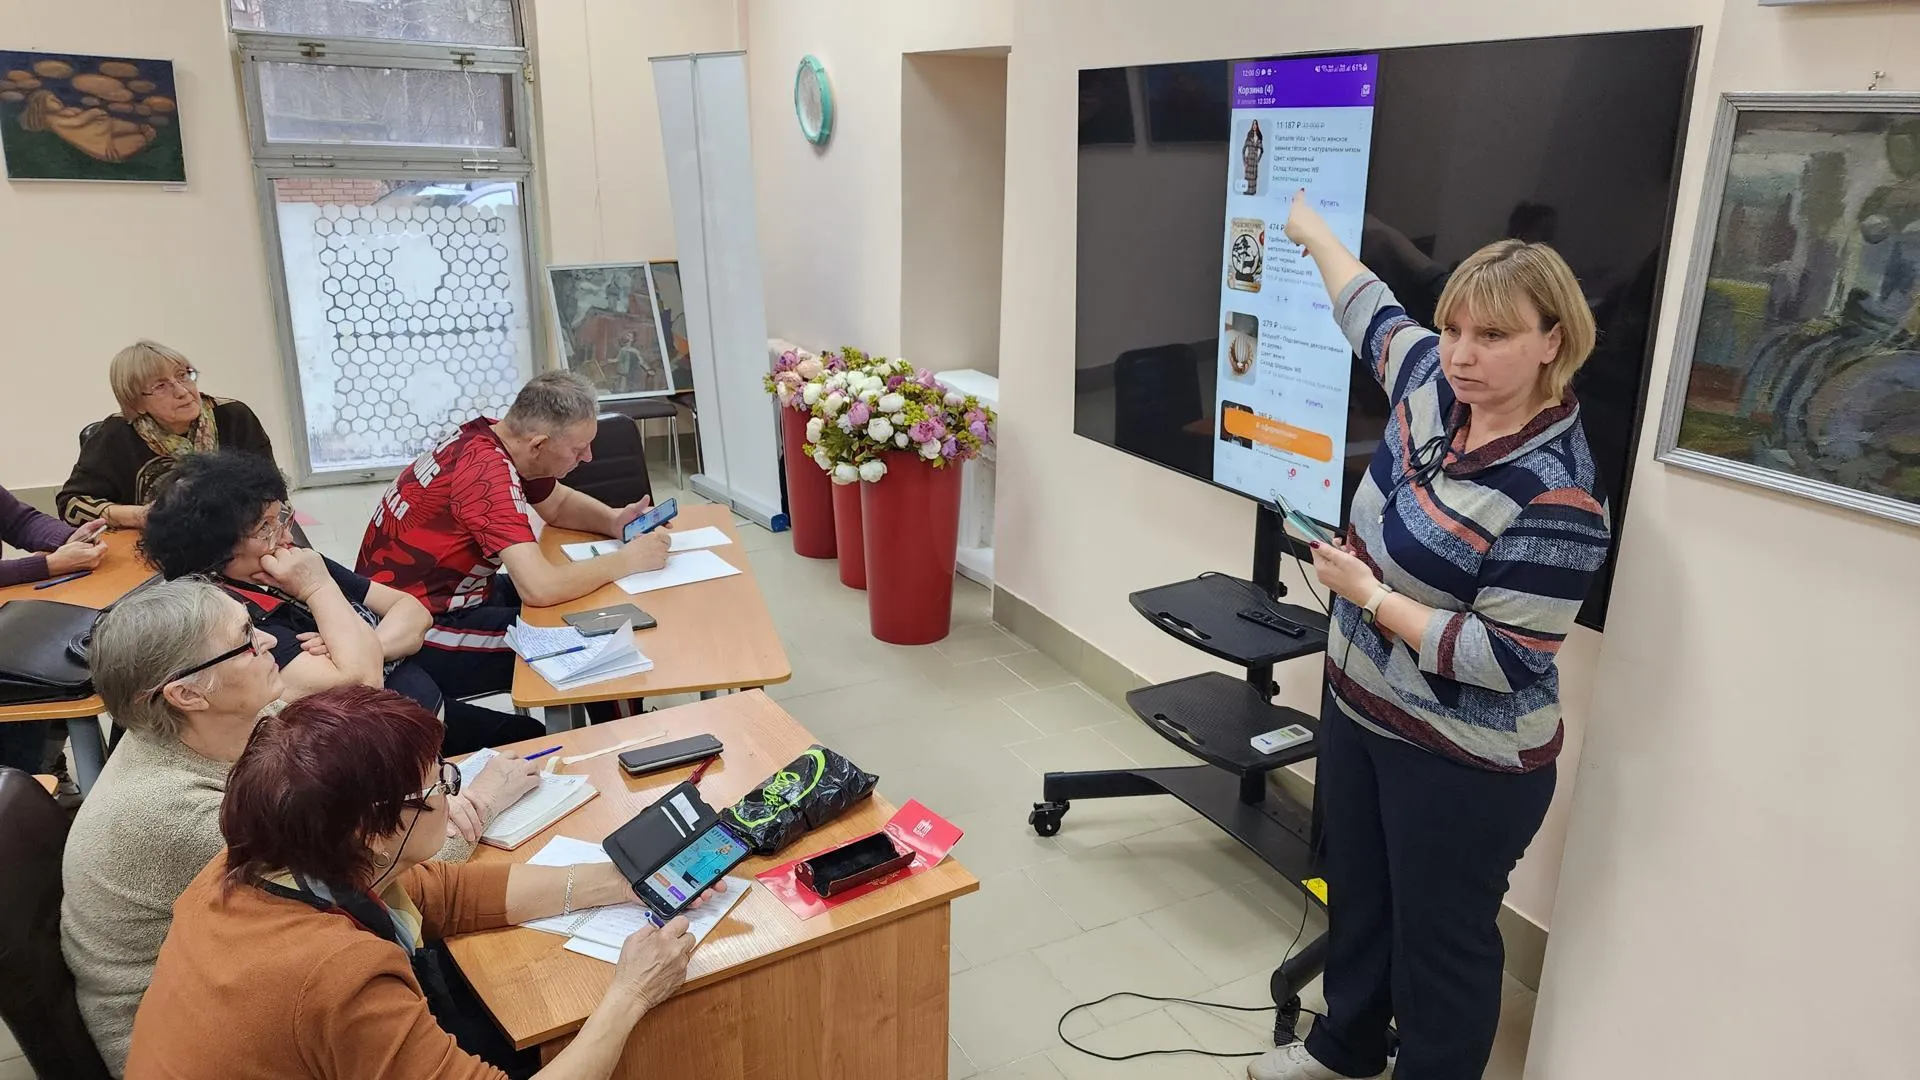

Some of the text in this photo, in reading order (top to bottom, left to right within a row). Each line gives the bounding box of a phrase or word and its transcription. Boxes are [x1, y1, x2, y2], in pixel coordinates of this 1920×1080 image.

[1238, 84, 1274, 96] Корзина (4)
[1320, 198, 1340, 207] Купить
[1269, 223, 1279, 231] 474
[1312, 302, 1331, 311] Купить
[1262, 319, 1273, 328] 279
[1305, 398, 1324, 409] Купить
